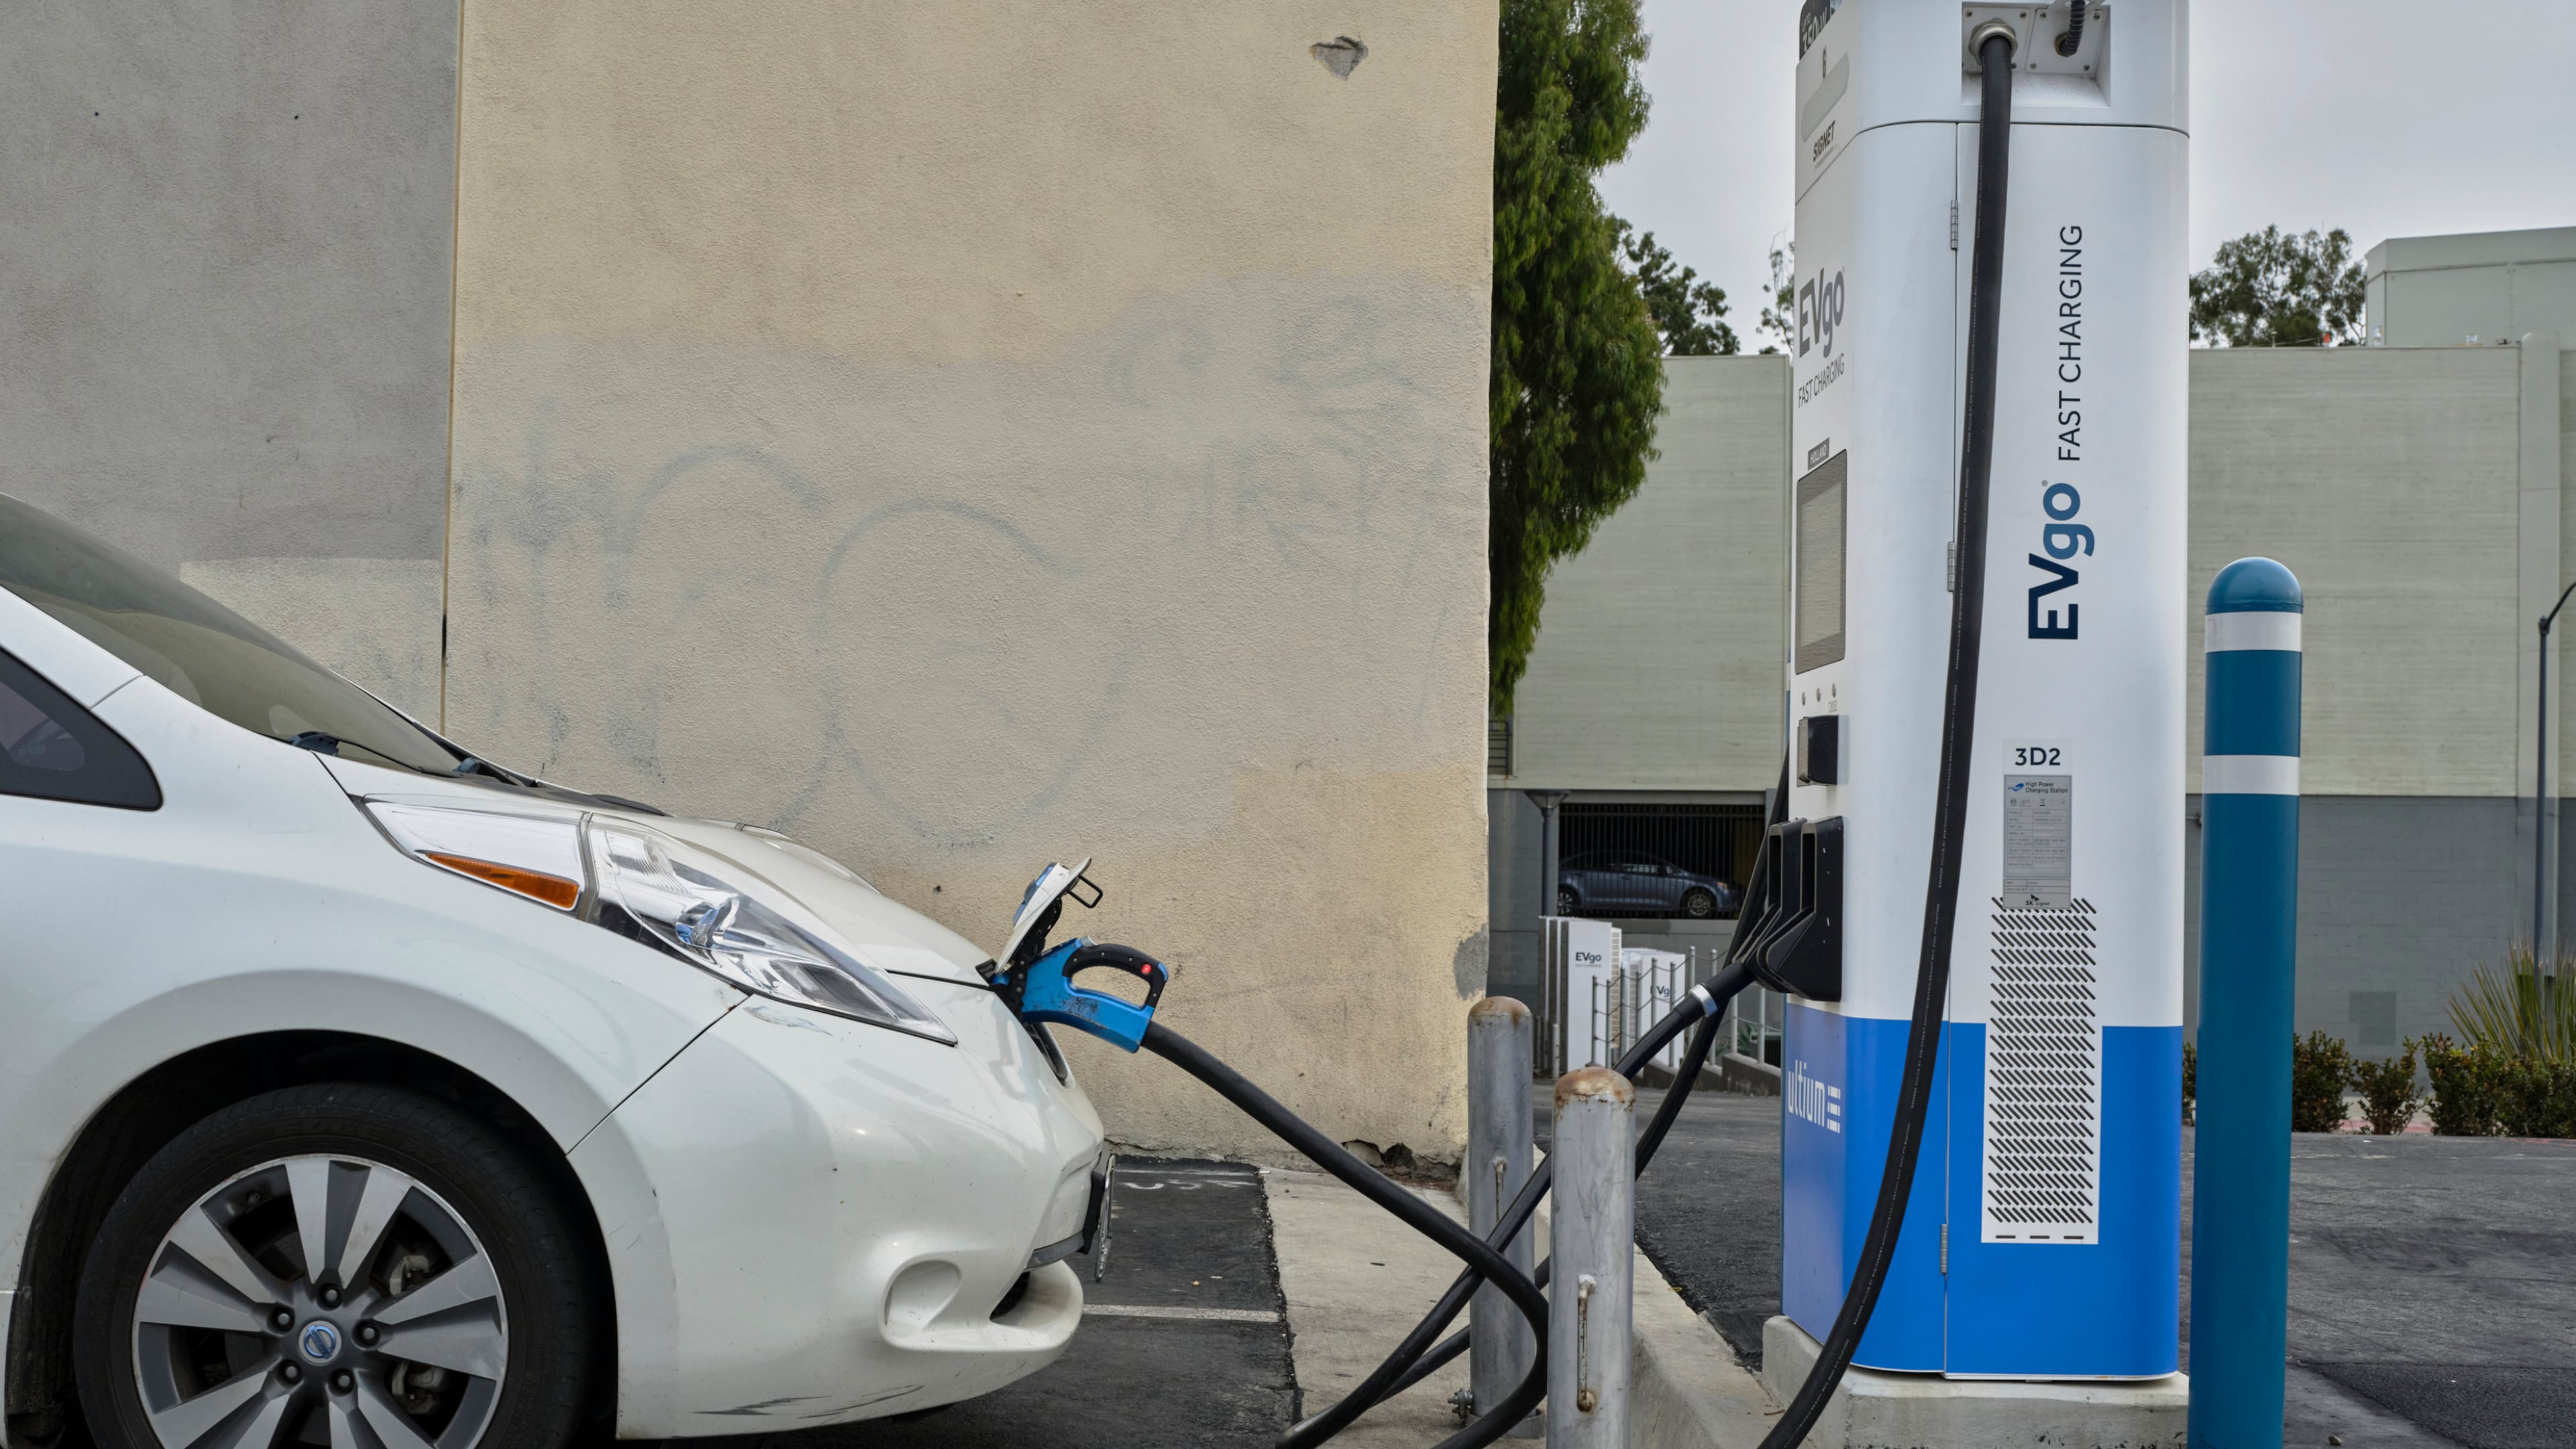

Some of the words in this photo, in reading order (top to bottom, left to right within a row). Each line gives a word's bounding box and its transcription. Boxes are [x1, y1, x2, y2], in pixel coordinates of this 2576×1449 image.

[1799, 268, 1845, 358] EVgo
[2058, 225, 2083, 383] CHARGING
[1799, 379, 1813, 408] FAST
[1813, 352, 1845, 396] CHARGING
[2058, 390, 2080, 462] FAST
[2028, 482, 2095, 640] EVgo
[2015, 747, 2061, 766] 3D2
[1575, 952, 1602, 964] EVgo
[1788, 1059, 1825, 1127] ultium
